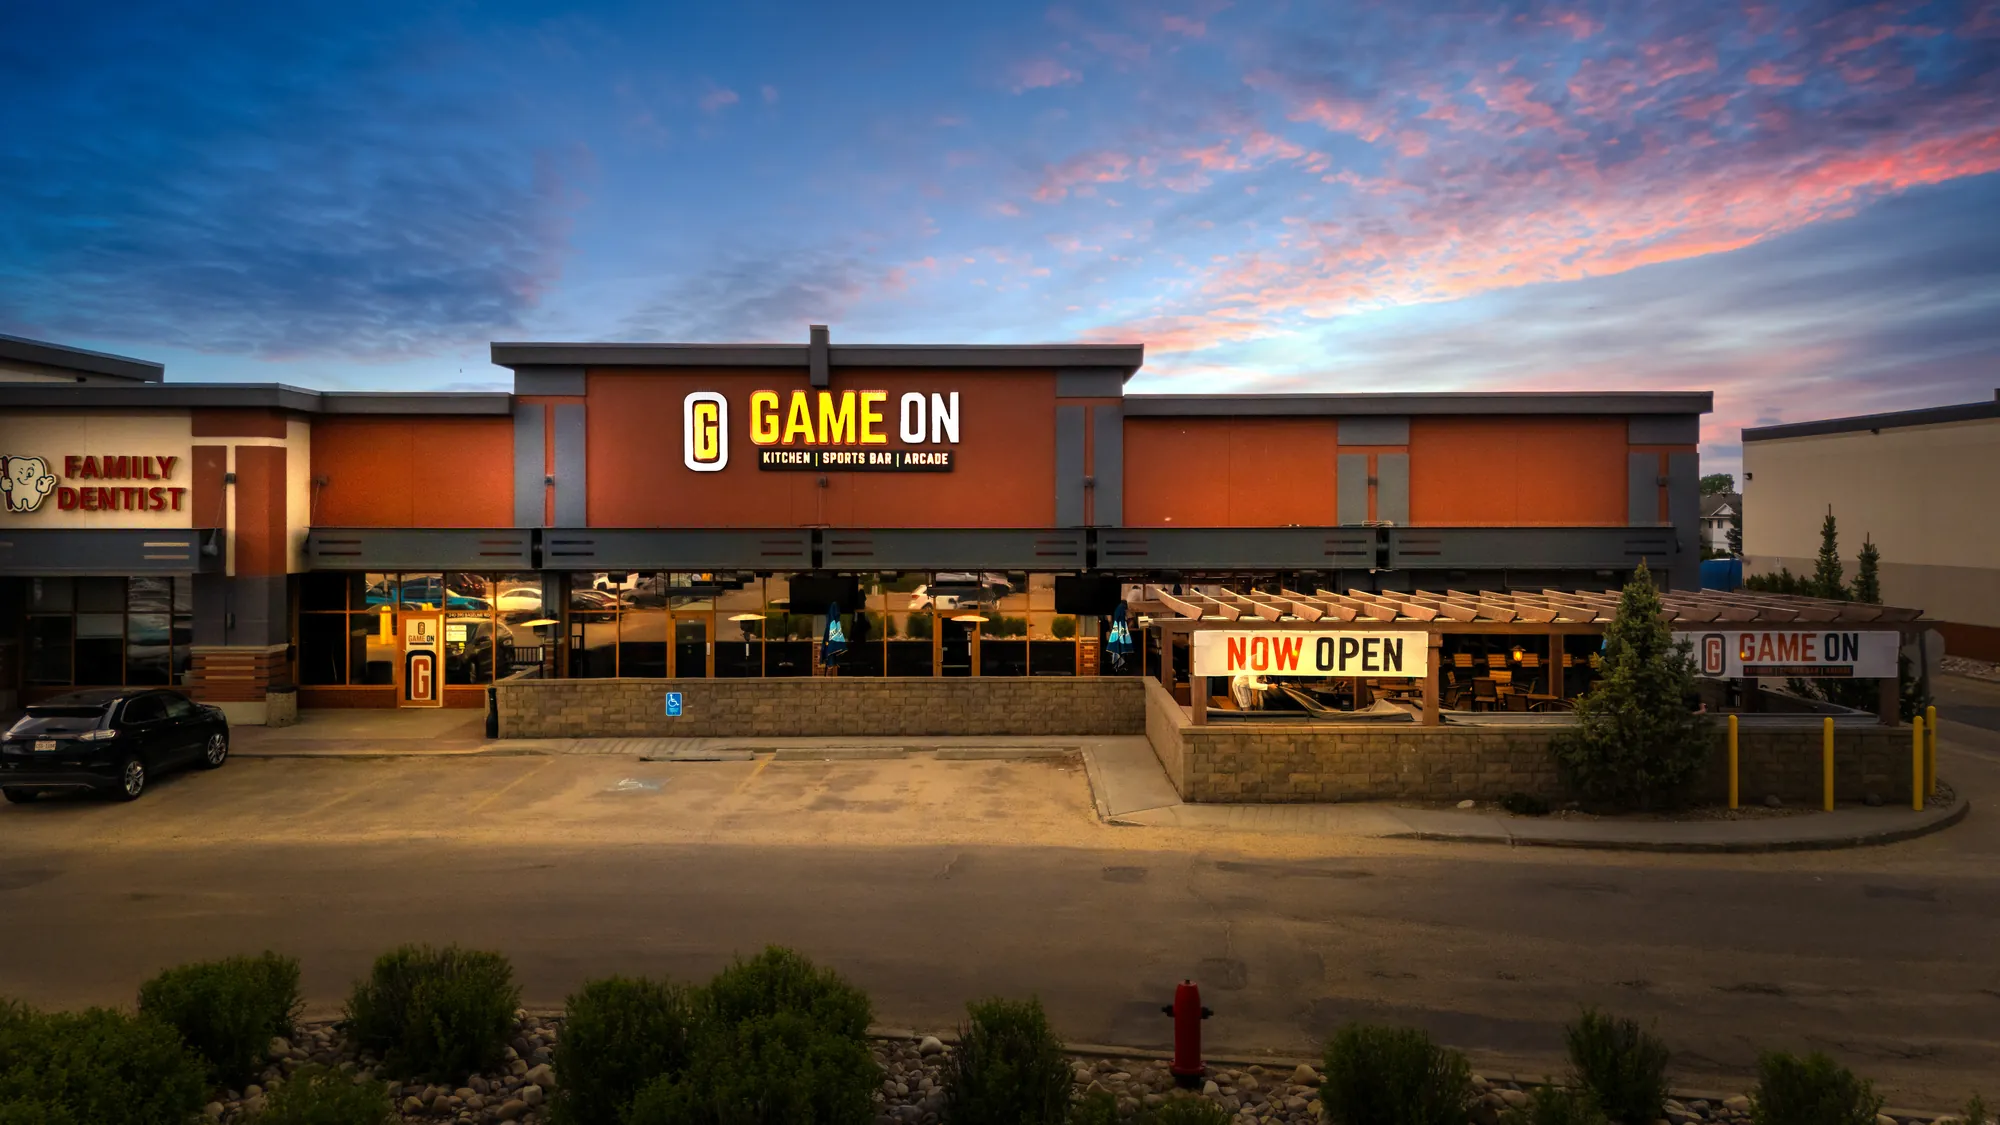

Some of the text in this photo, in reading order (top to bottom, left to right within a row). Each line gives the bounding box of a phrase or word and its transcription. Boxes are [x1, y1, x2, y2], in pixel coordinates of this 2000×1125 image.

[694, 403, 718, 460] G
[750, 391, 960, 444] GAME ON
[65, 456, 178, 479] FAMILY
[763, 452, 949, 465] KITCHEN SPORTS BAR ARCADE
[57, 487, 186, 511] DENTIST
[1227, 637, 1403, 672] NOW OPEN
[1707, 640, 1720, 671] G
[1739, 633, 1859, 661] GAME ON
[413, 659, 429, 698] G
